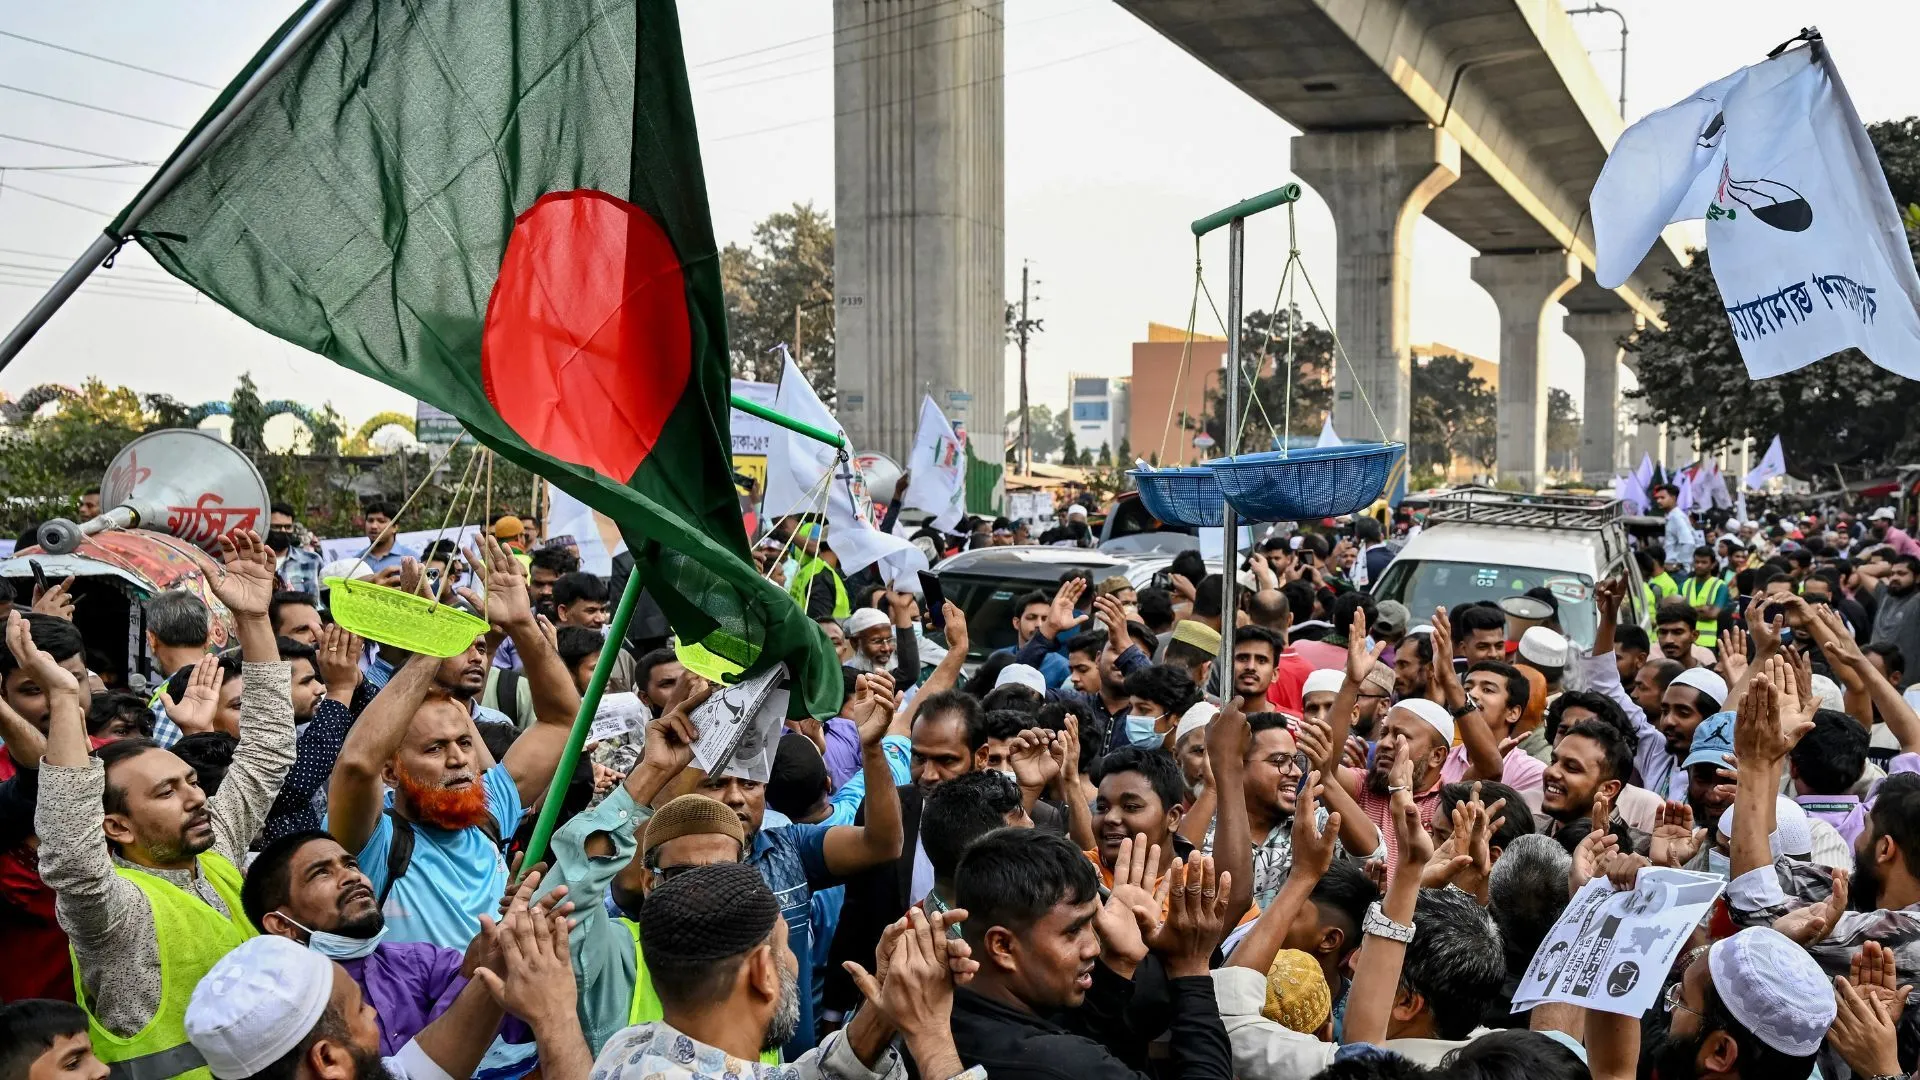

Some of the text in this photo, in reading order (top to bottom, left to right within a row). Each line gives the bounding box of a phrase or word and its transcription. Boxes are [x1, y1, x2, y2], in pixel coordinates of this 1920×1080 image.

[841, 297, 863, 305] P339
[1477, 579, 1494, 587] 05
[1582, 937, 1611, 987] ঢাকা-১৫
